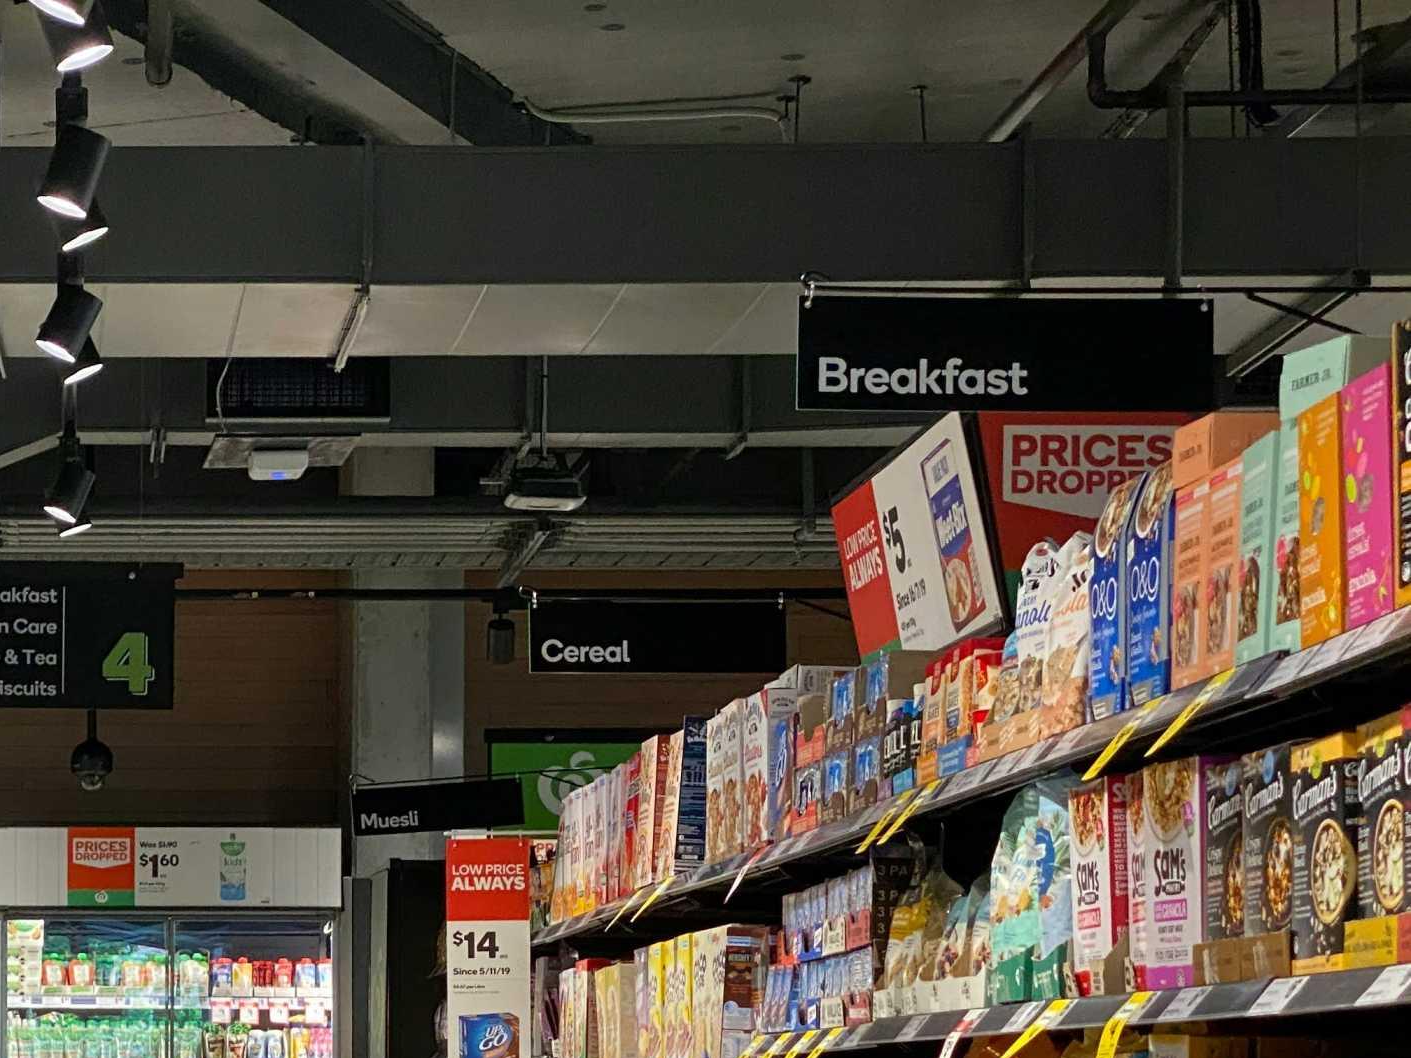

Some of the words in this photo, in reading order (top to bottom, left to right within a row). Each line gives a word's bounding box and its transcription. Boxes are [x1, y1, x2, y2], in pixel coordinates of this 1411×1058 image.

[817, 356, 1028, 397] Breakfast
[1011, 434, 1173, 467] PRICES
[1011, 470, 1144, 495] DROPP
[844, 533, 860, 560] LOW
[859, 519, 879, 549] PRICE
[849, 547, 884, 592] ALWAYS
[13, 618, 58, 635] Care
[4, 649, 19, 665] &
[23, 649, 57, 665] Tea
[541, 638, 631, 664] Cereal
[102, 632, 155, 696] 4
[360, 810, 420, 830] Muesli
[75, 841, 128, 852] PRICES
[139, 841, 157, 849] Was
[75, 852, 128, 862] DROPPED
[452, 864, 481, 875] LOW
[484, 863, 525, 875] PRICE
[451, 876, 526, 891] ALWAYS
[453, 931, 499, 959] $14
[453, 967, 478, 976] Since
